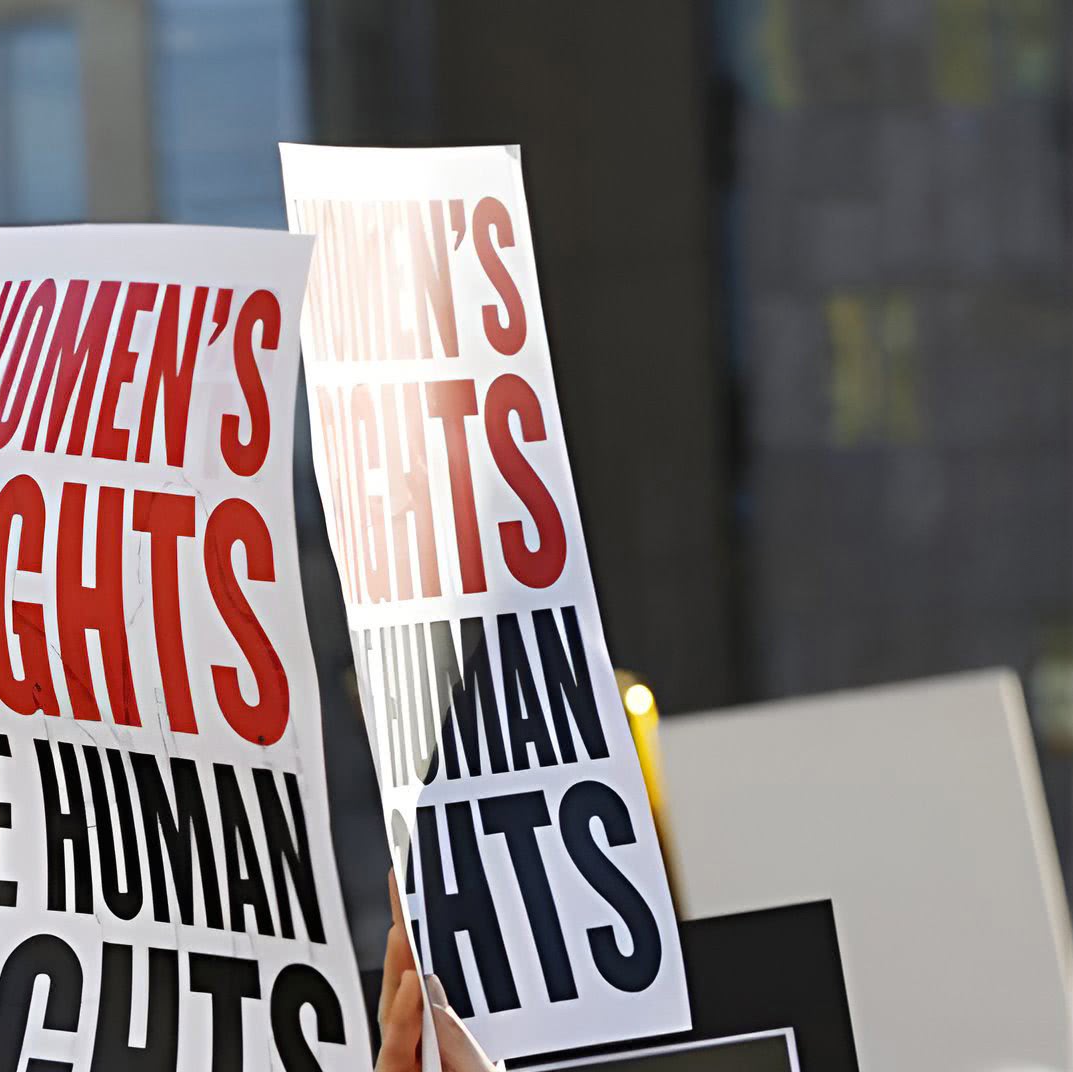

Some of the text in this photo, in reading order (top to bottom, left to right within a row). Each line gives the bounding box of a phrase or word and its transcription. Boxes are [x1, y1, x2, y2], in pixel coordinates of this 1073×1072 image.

[316, 373, 567, 605] RIGHTS
[379, 606, 610, 787] HUMAN
[33, 738, 327, 945] HUMAN
